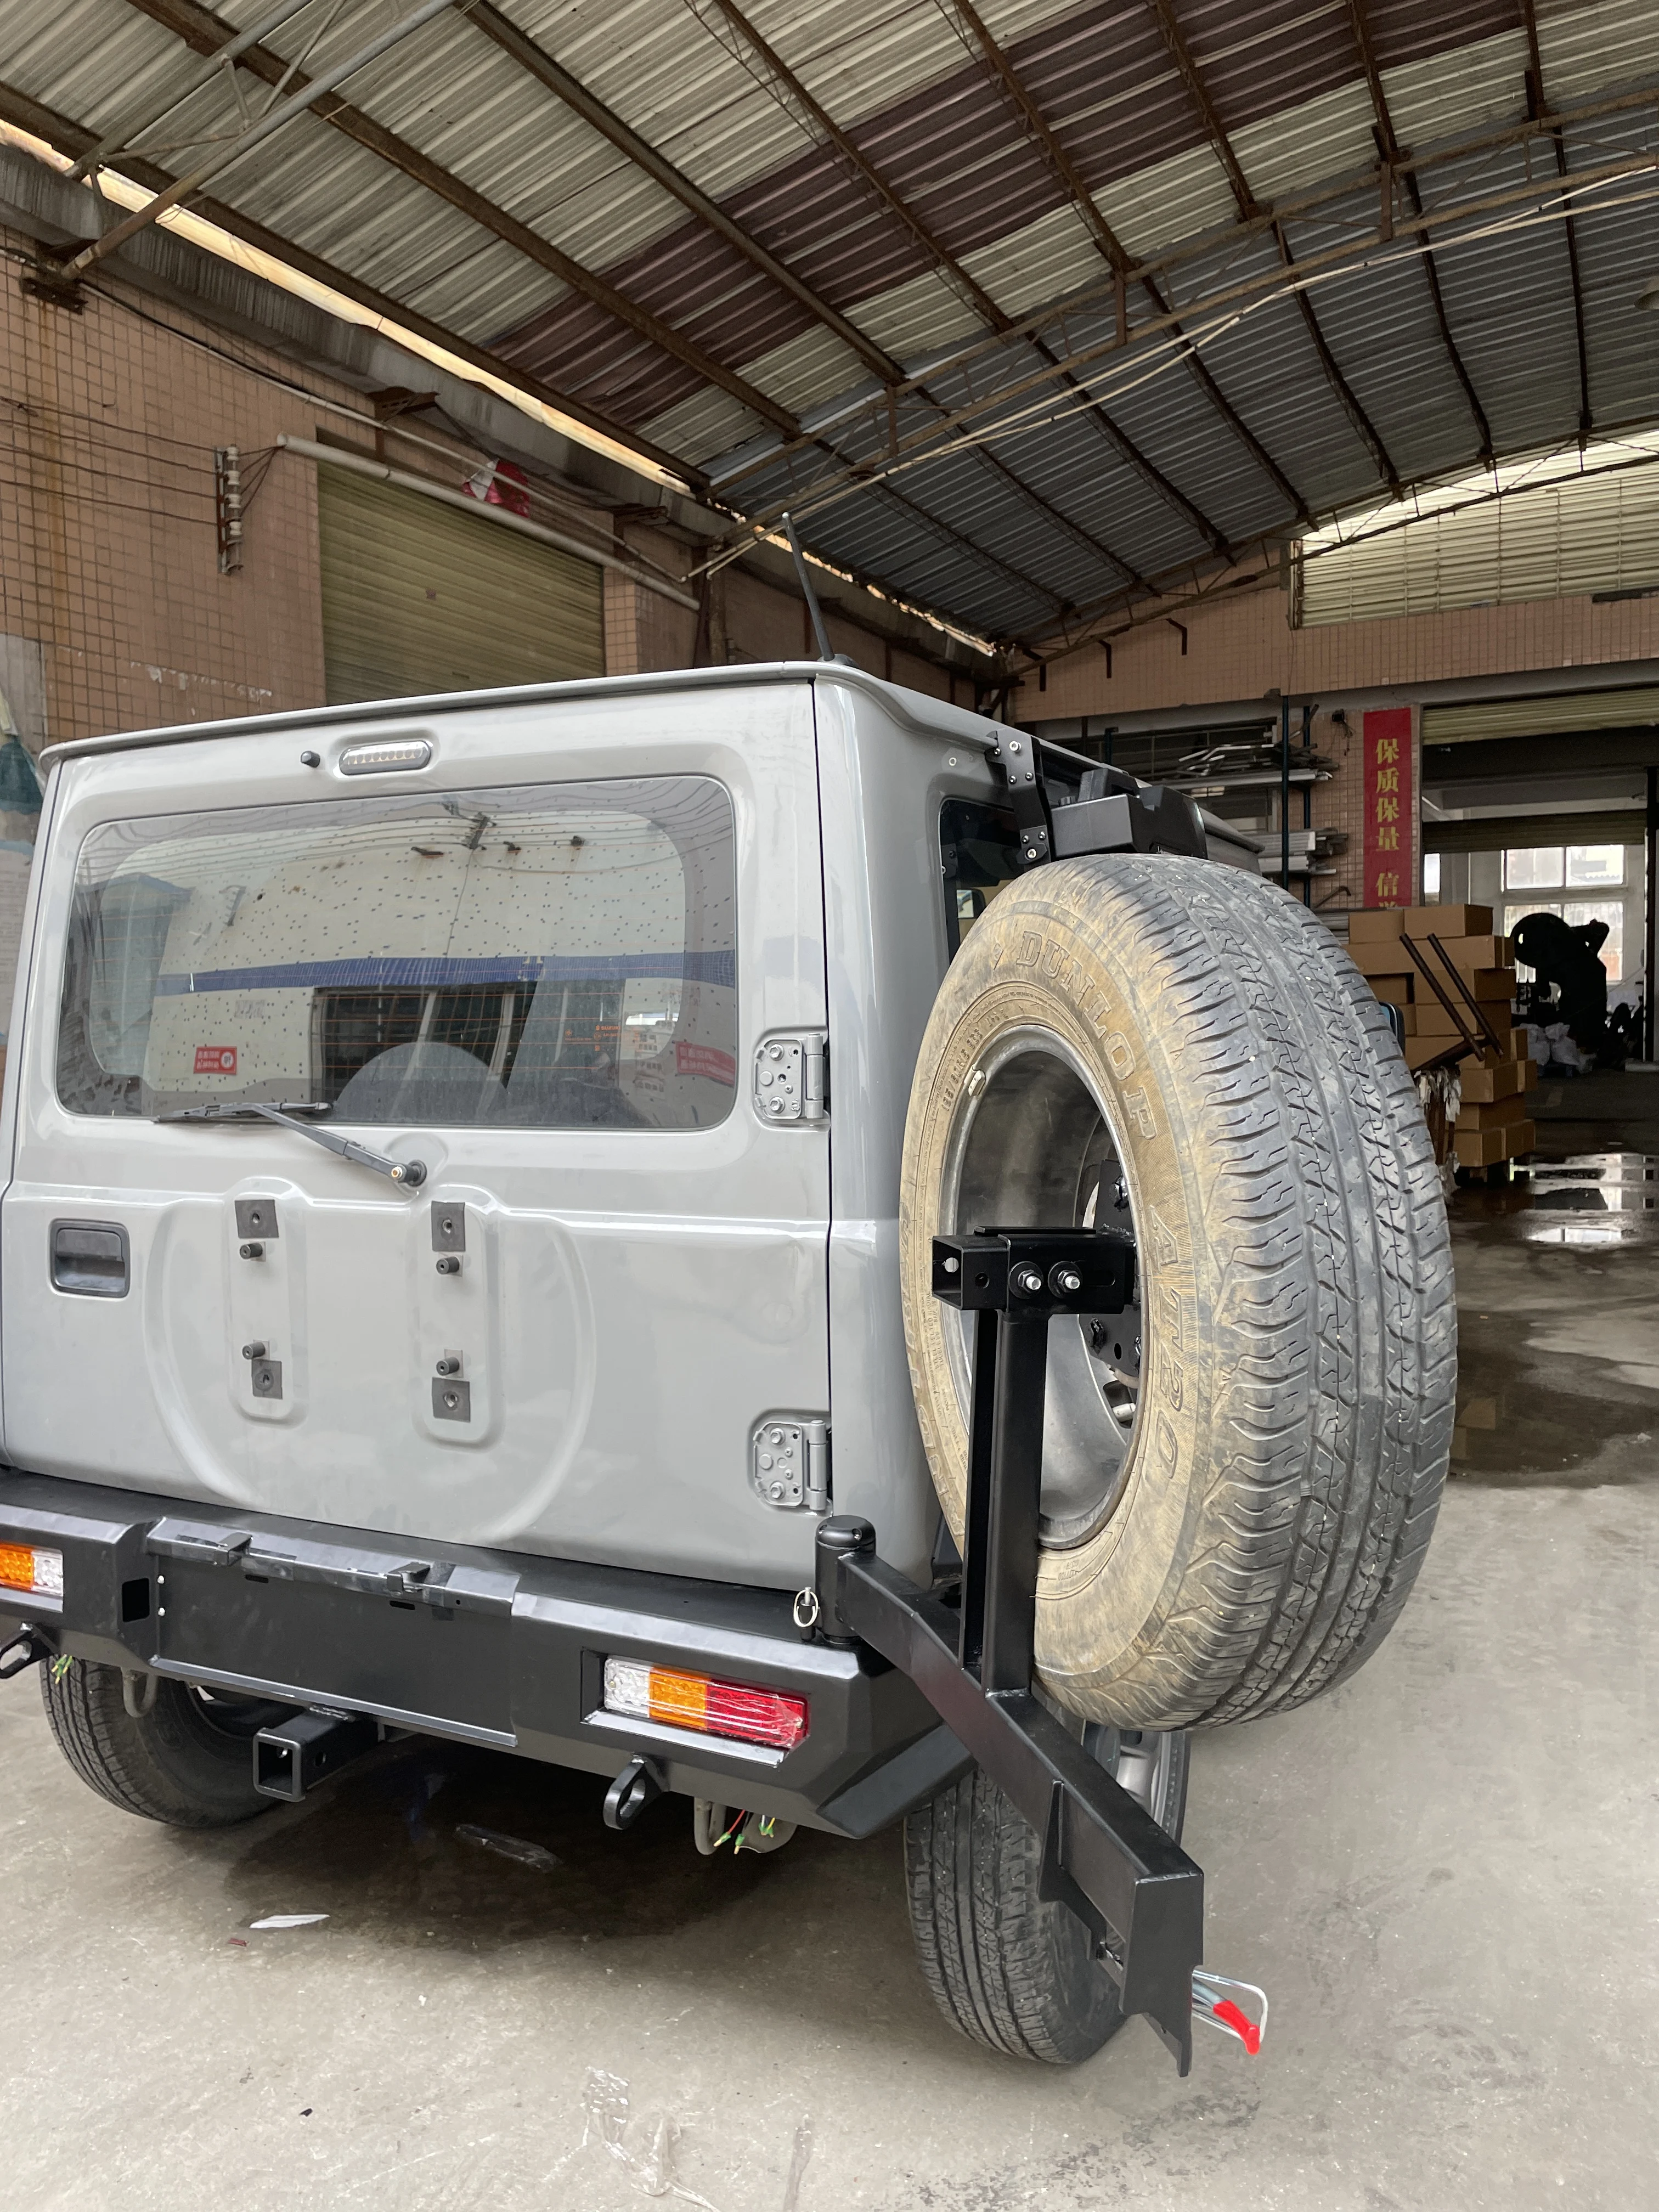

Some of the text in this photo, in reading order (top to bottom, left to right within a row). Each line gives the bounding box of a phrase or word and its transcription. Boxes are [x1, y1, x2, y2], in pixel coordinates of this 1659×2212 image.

[1375, 738, 1400, 908] 保质保量 信
[1016, 930, 1157, 1139] DUNLOP
[1150, 1204, 1183, 1480] AT20
